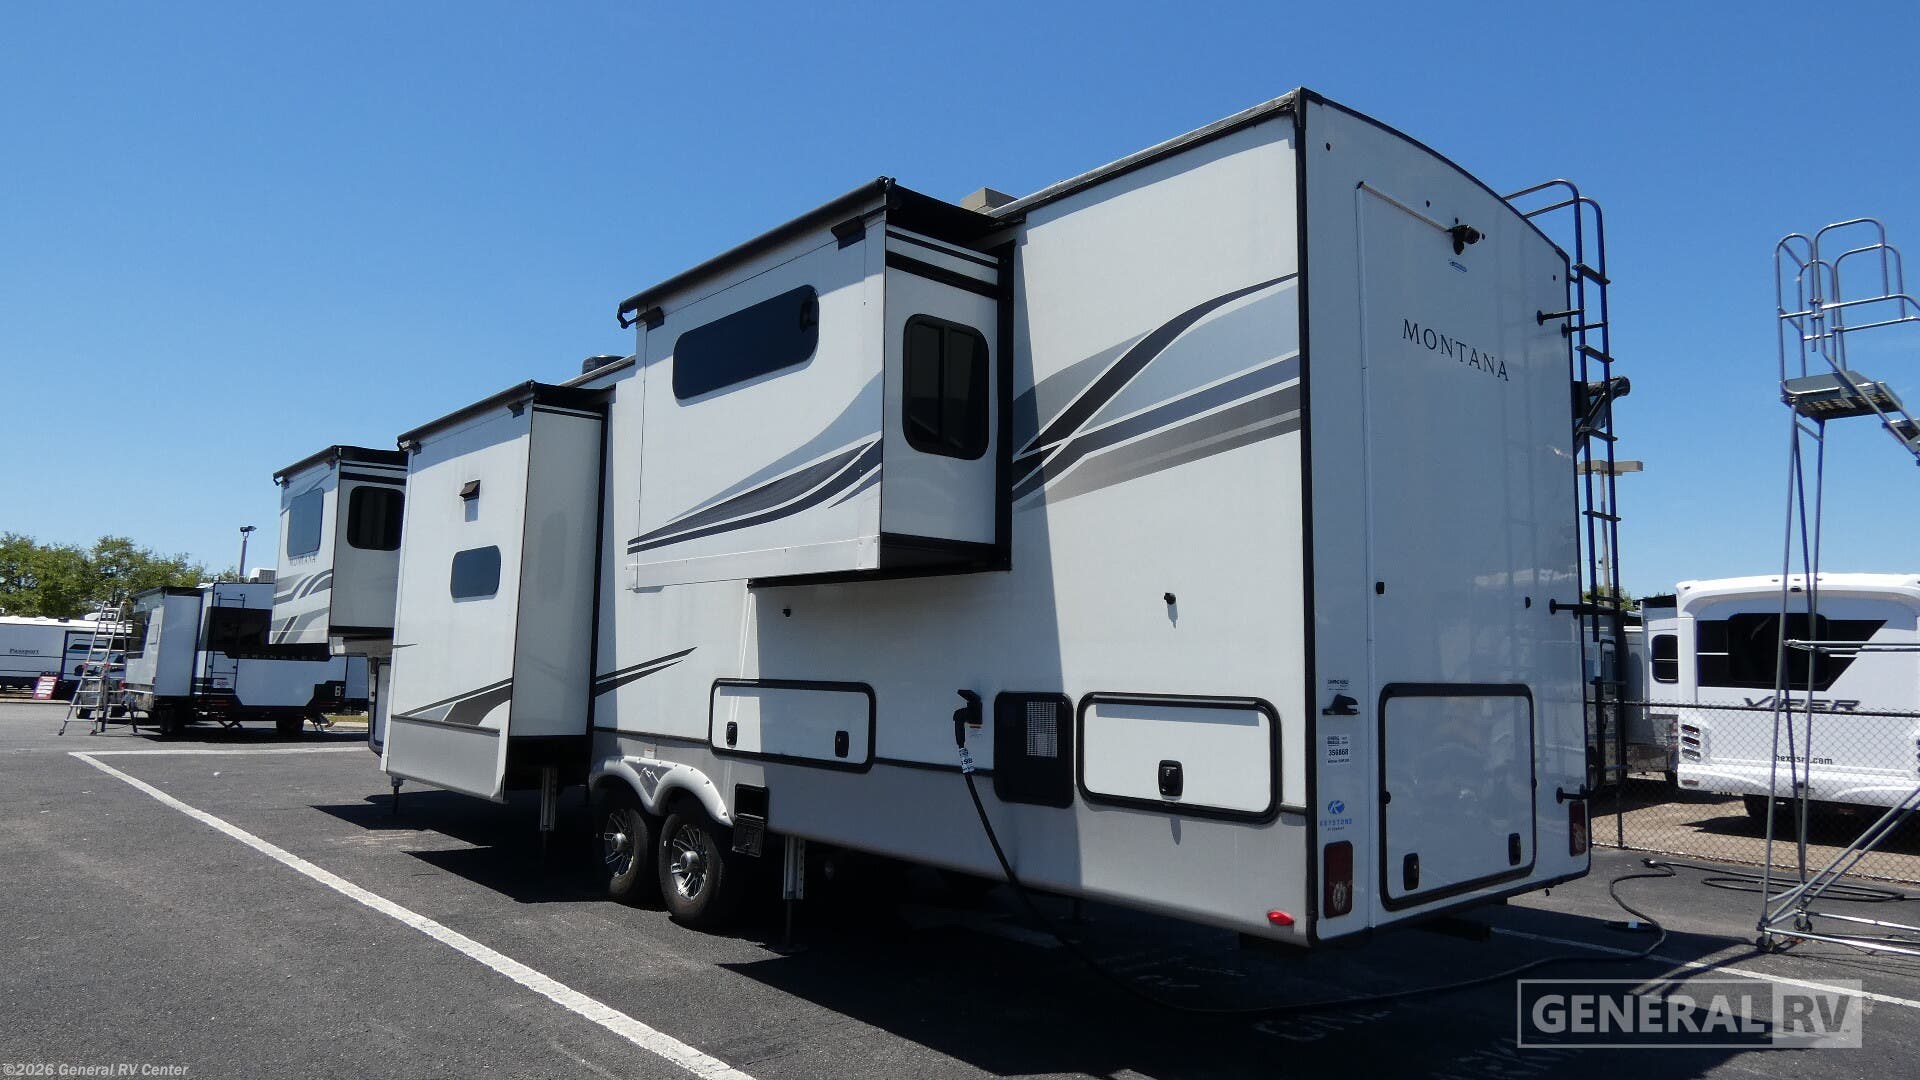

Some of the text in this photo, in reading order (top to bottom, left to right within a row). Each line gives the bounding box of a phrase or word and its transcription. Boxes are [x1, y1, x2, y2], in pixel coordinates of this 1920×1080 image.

[1402, 318, 1509, 382] MONTANA
[1743, 696, 1861, 711] VIPER
[1776, 755, 1833, 765] nexsr.com
